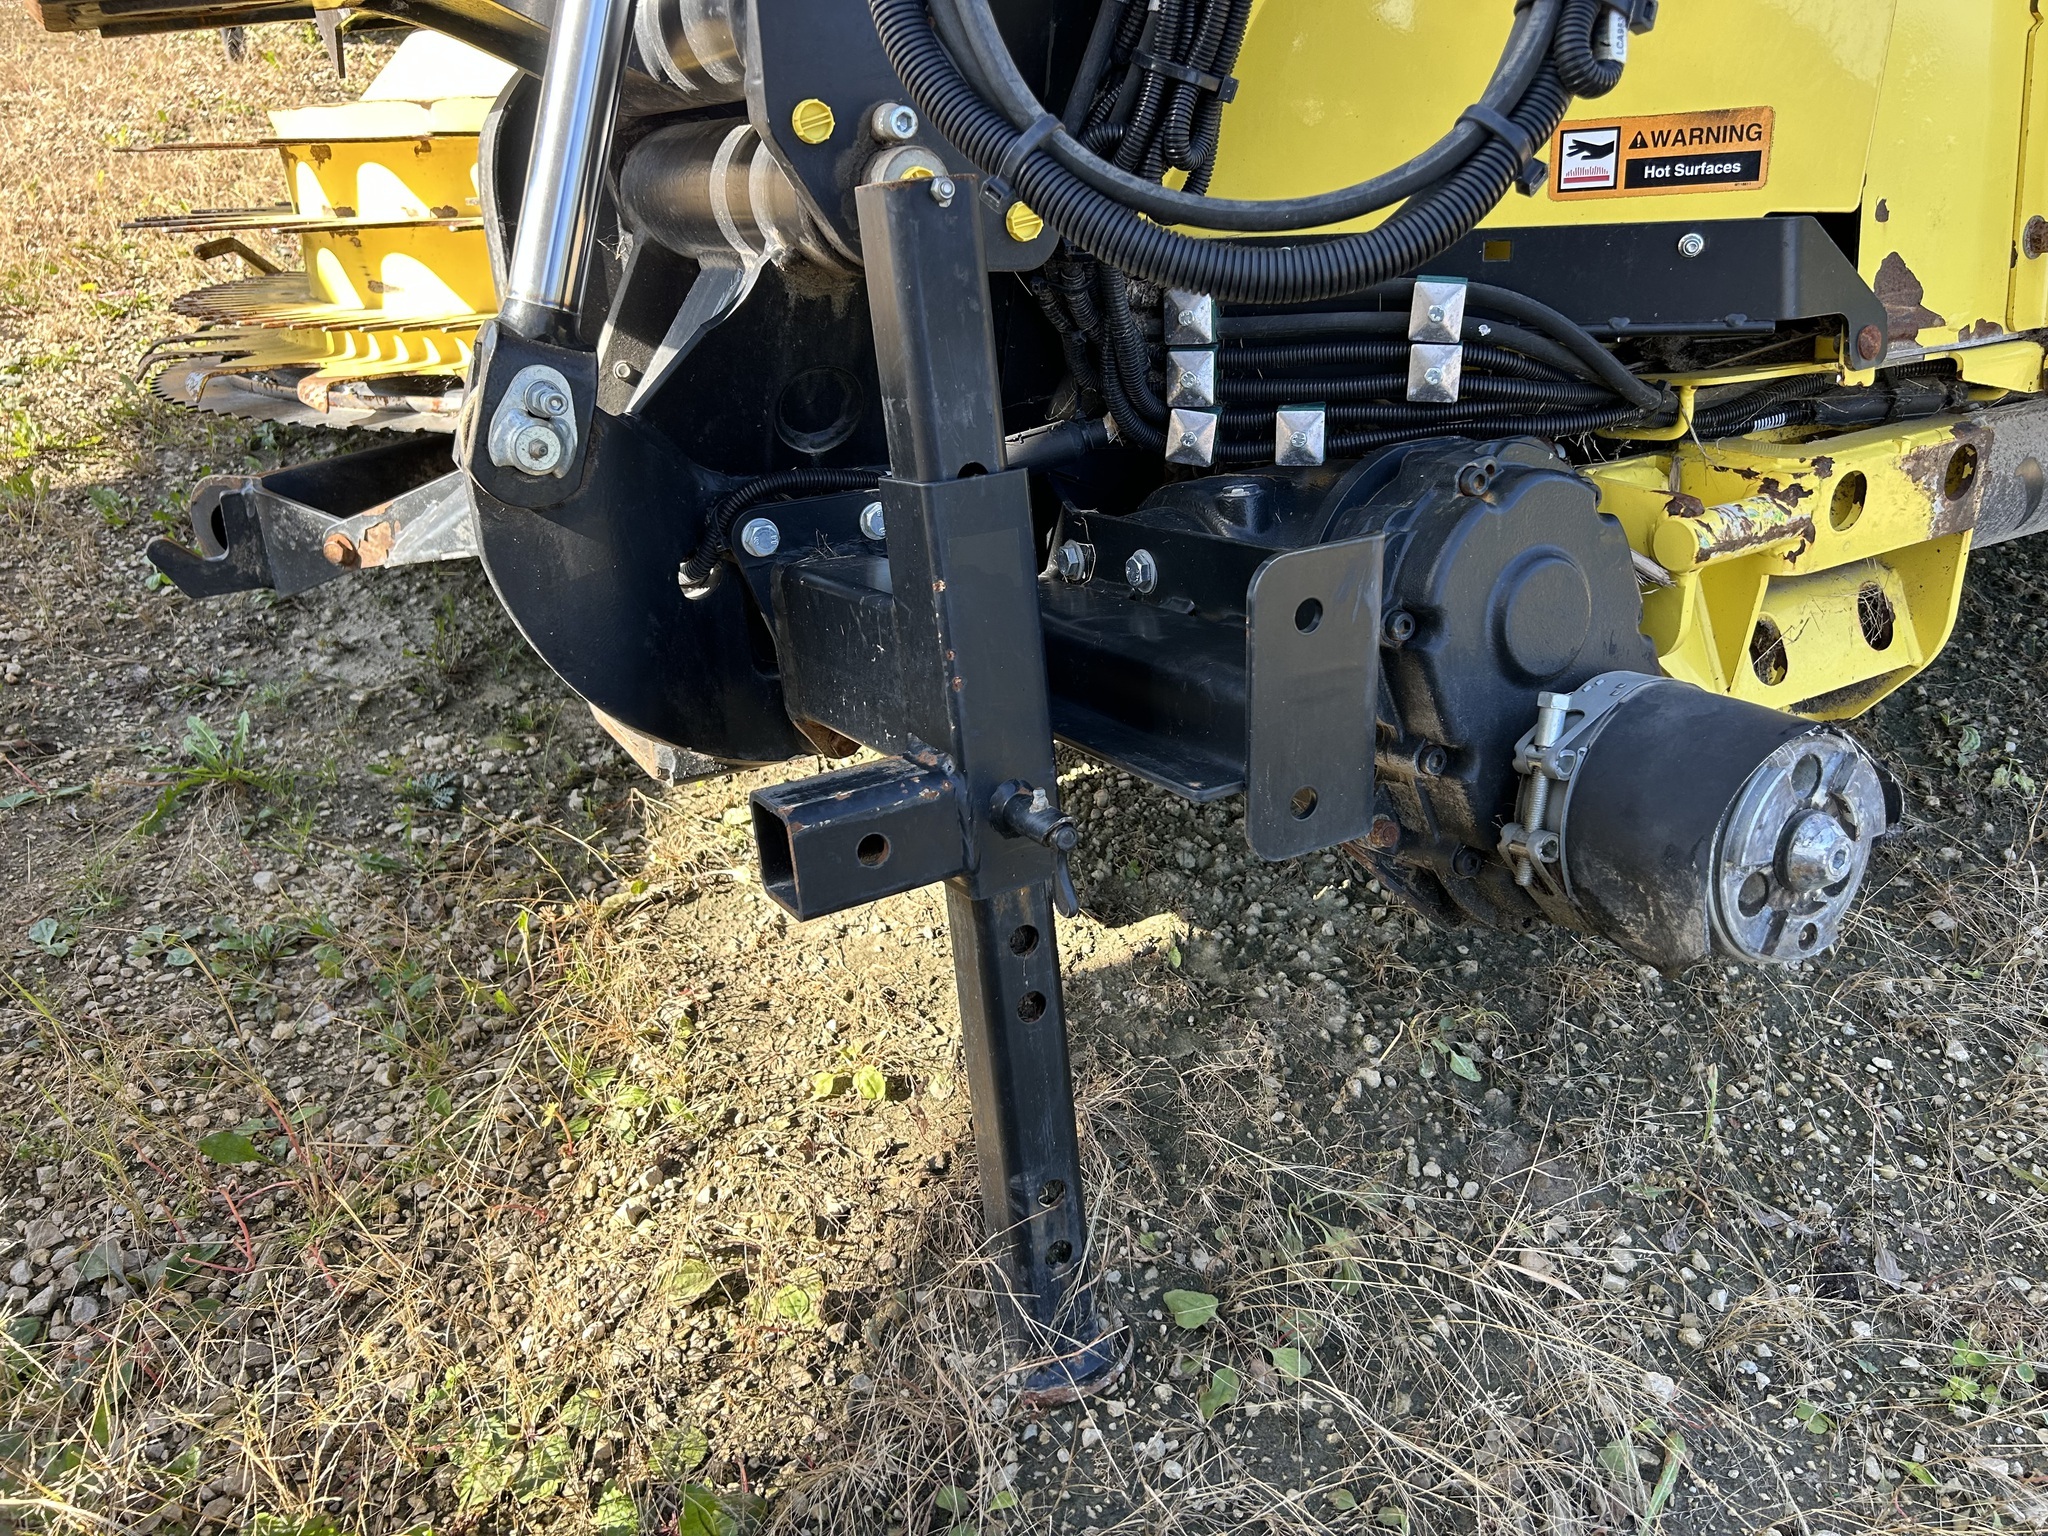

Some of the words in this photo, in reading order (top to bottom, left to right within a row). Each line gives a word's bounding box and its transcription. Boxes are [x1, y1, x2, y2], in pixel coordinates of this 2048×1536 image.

[1651, 123, 1762, 148] WARNING
[1644, 165, 1671, 179] Hot
[1674, 161, 1742, 177] Surfaces
